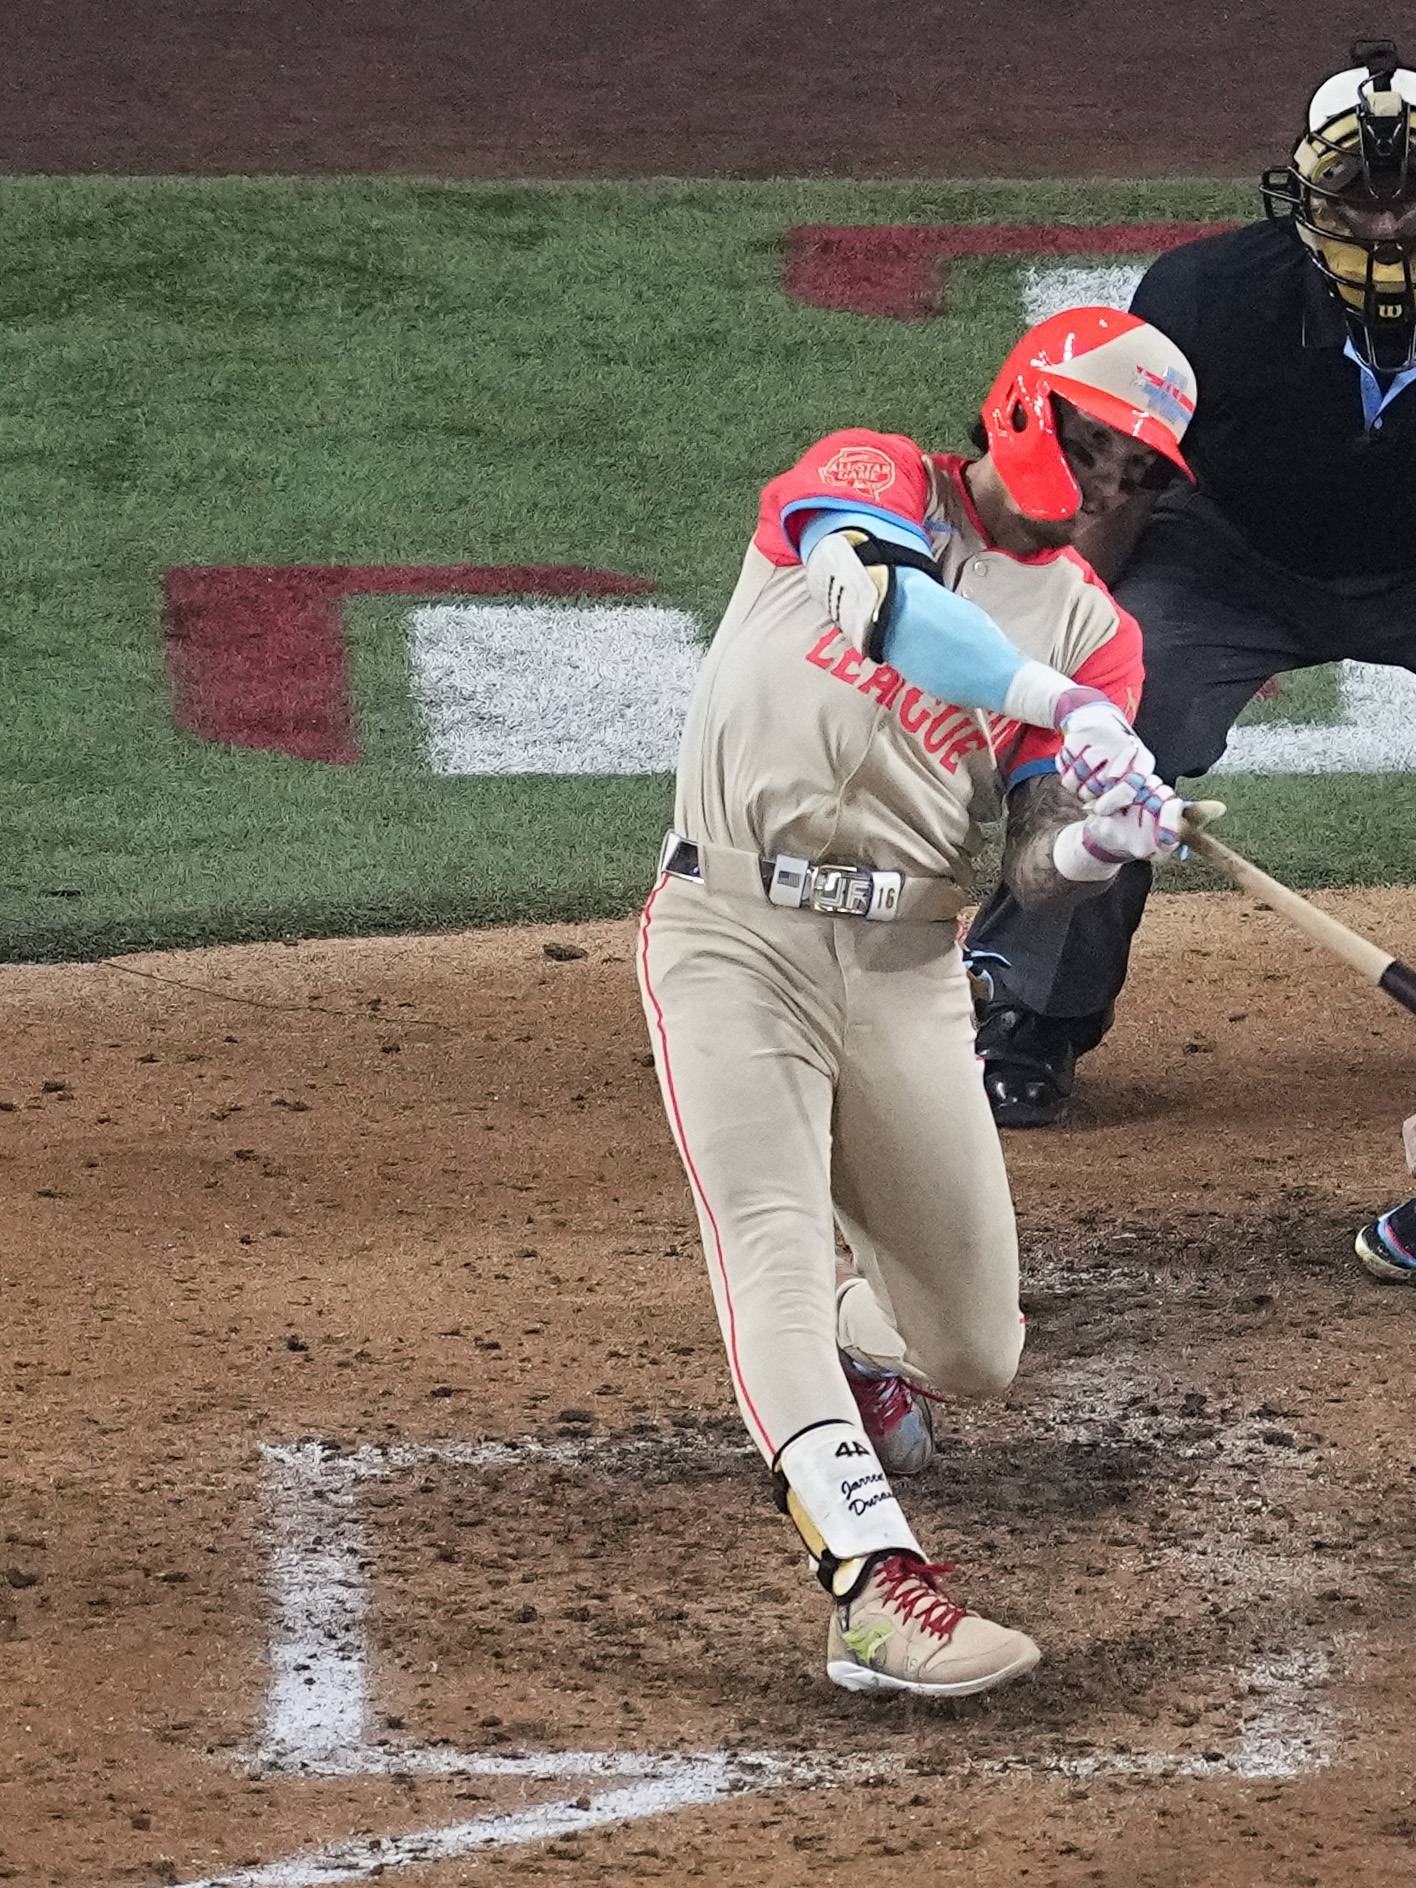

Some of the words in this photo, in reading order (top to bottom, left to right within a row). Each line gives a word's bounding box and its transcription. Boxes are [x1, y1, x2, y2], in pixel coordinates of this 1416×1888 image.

[837, 470, 879, 481] GAME
[805, 625, 988, 775] LEAGUE
[877, 886, 897, 909] 16
